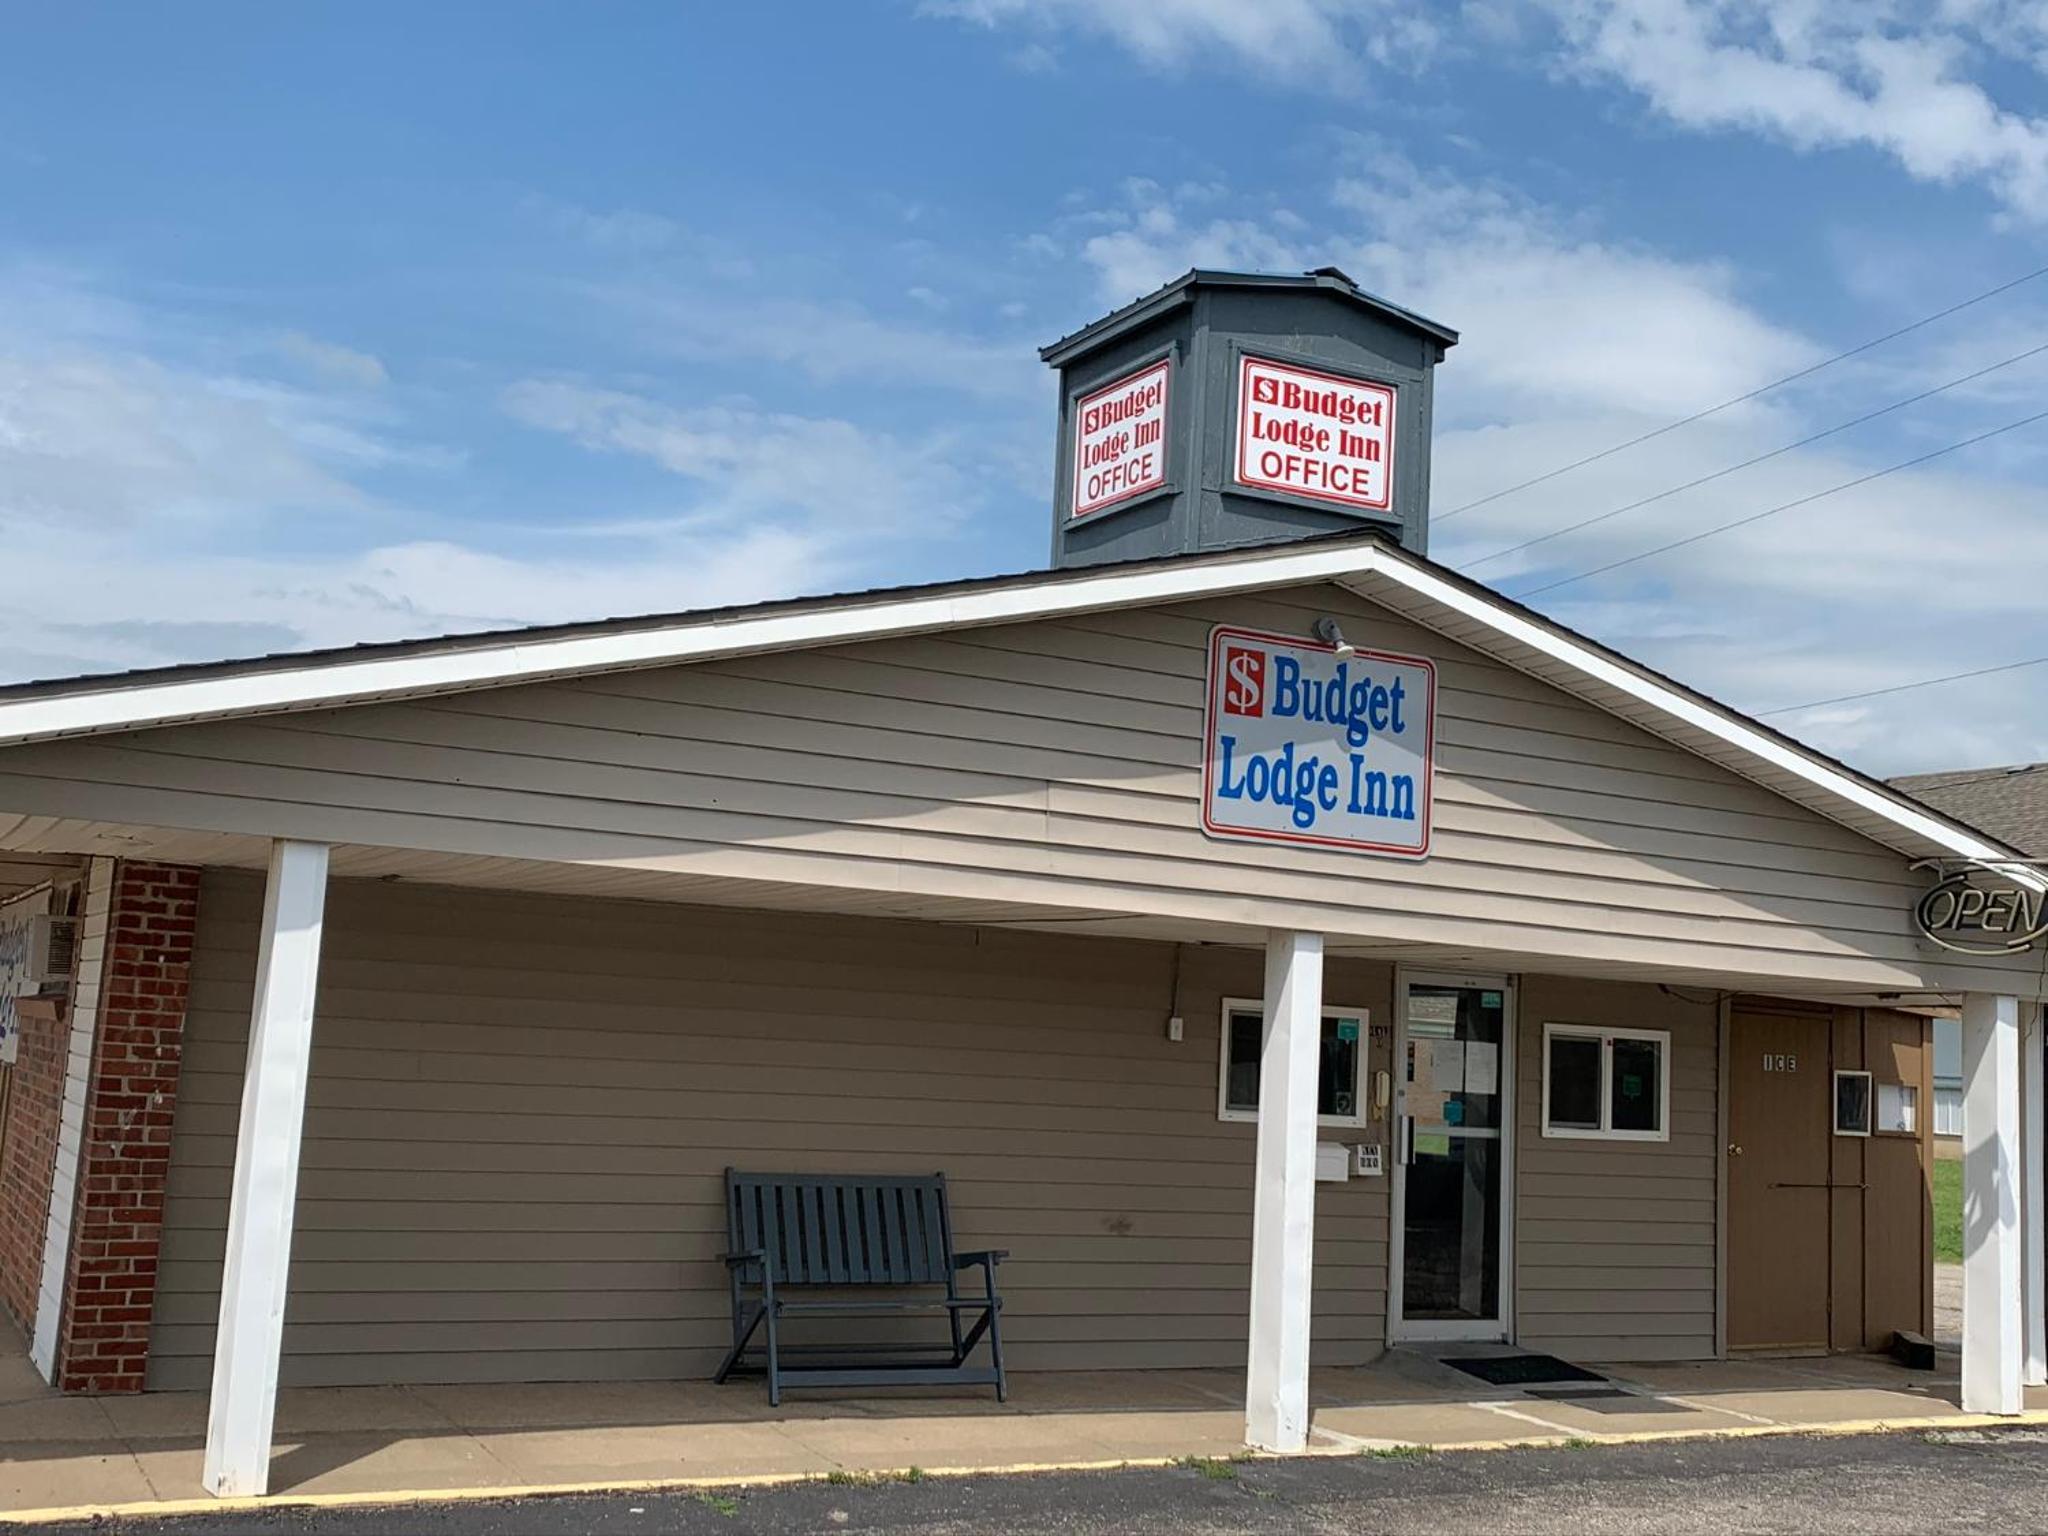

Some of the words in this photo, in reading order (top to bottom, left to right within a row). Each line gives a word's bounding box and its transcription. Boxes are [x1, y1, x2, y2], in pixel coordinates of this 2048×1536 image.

[1101, 378, 1162, 429] Budget
[1282, 381, 1382, 427] Budget
[1084, 430, 1129, 470] Lodge
[1134, 418, 1160, 449] Inn
[1252, 411, 1330, 452] Lodge
[1338, 429, 1380, 462] Inn
[1088, 453, 1153, 500] OFFICE
[1260, 451, 1370, 496] OFFICE
[1271, 655, 1406, 748] Budget
[1217, 735, 1339, 829] Lodge
[1346, 753, 1415, 820] Inn
[1923, 889, 2045, 932] OPEN
